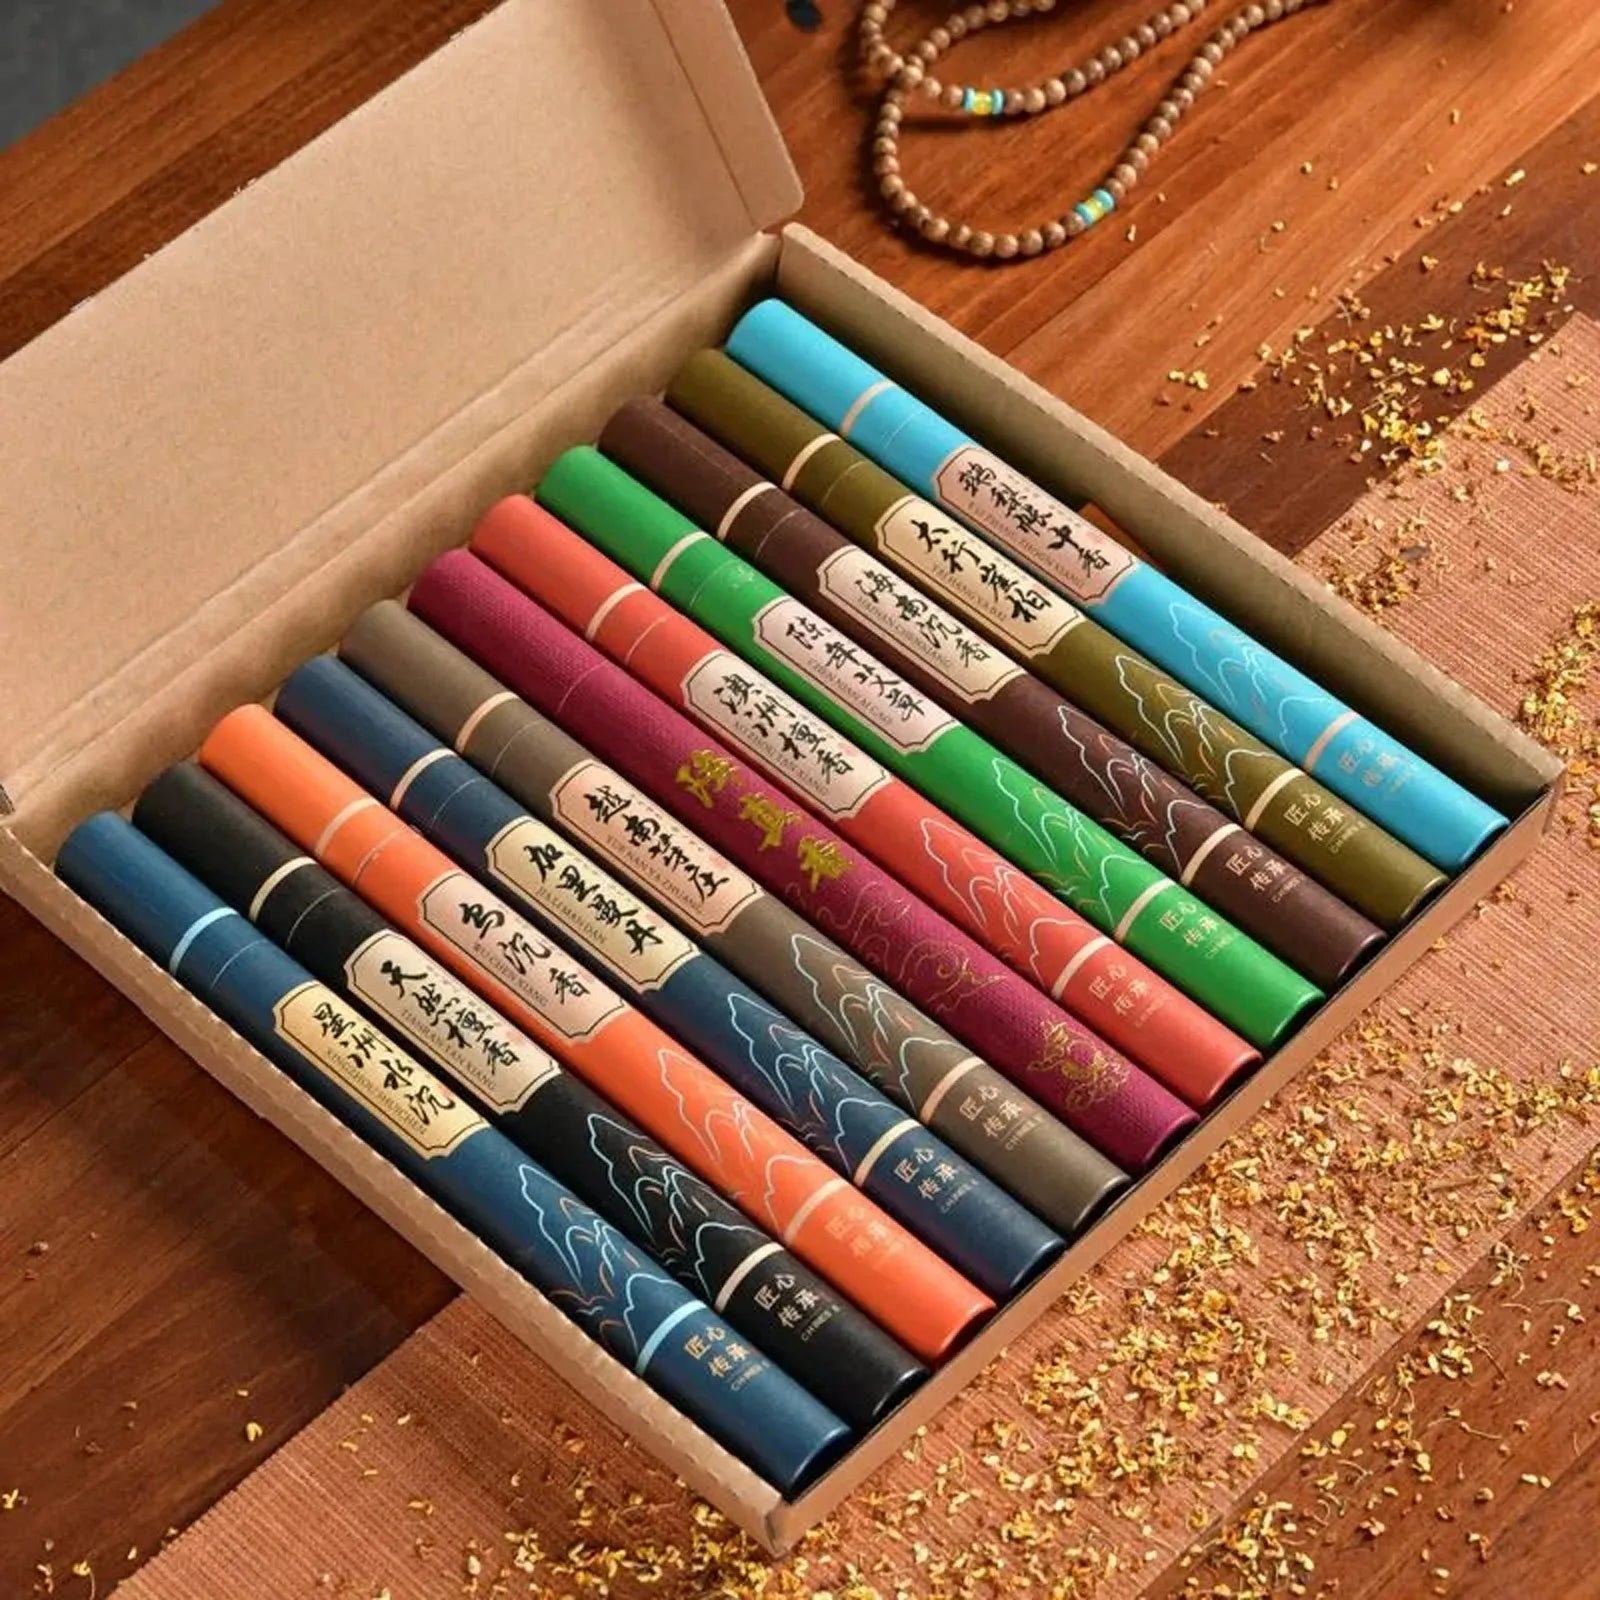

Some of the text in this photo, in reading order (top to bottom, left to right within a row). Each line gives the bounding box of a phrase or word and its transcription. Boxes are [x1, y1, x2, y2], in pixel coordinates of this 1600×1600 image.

[1284, 793, 1321, 826] 匠心
[1308, 807, 1344, 840] 传承
[1225, 846, 1262, 876] 匠心
[1250, 860, 1286, 891] 传承
[960, 1086, 998, 1120] 匠心
[983, 1100, 1023, 1138] 传承
[895, 1147, 934, 1183] 匠心
[918, 1163, 958, 1200] 传承
[754, 1274, 795, 1310] 匠心
[779, 1288, 820, 1328] 传承
[685, 1327, 725, 1360] 匠心
[707, 1342, 750, 1377] 传承
